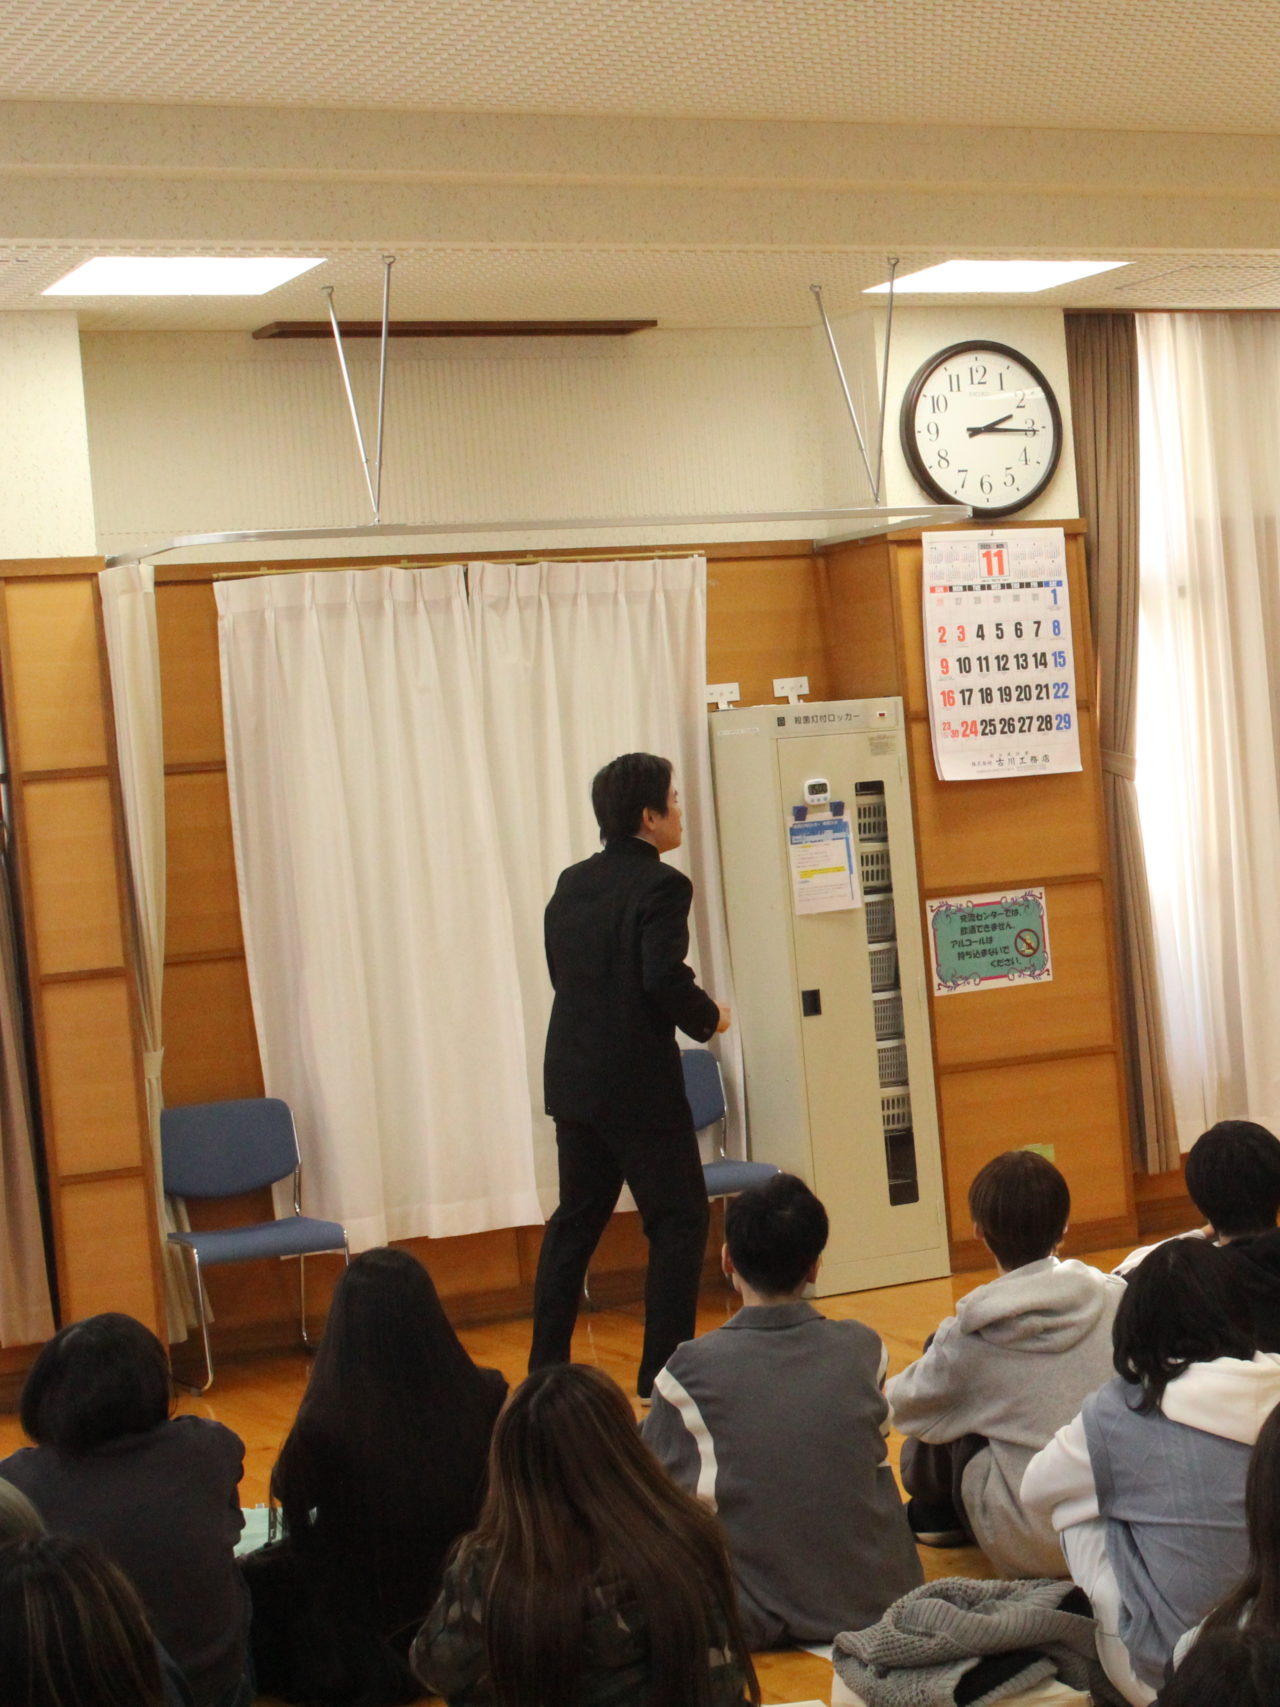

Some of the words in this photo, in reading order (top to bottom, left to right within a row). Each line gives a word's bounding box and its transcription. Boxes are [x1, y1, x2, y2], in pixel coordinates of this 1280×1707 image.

[948, 374, 961, 392] 11
[968, 365, 987, 385] 12
[997, 372, 1005, 391] 1
[931, 395, 948, 414] 10
[1015, 391, 1026, 408] 2
[927, 422, 939, 441] 9
[1024, 418, 1036, 438] 3
[937, 449, 950, 469] 8
[1018, 446, 1030, 466] 4
[957, 470, 968, 489] 7
[980, 474, 993, 495] 6
[1003, 467, 1016, 487] 5
[982, 550, 1004, 576] 11
[1050, 588, 1058, 605] 1
[938, 626, 947, 643] 2
[957, 625, 966, 642] 3
[976, 624, 985, 641] 4
[995, 623, 1004, 640] 5
[1014, 622, 1023, 638] 6
[1033, 621, 1042, 638] 7
[1052, 619, 1061, 636] 8
[940, 658, 950, 675] 9
[956, 656, 972, 674] 10
[976, 655, 990, 672] 11
[994, 654, 1010, 671] 12
[1014, 653, 1029, 670] 13
[1032, 652, 1048, 669] 14
[1051, 651, 1066, 668] 15
[940, 689, 956, 707] 16
[959, 688, 974, 706] 17
[978, 687, 993, 704] 18
[997, 686, 1012, 703] 19
[1015, 684, 1032, 702] 20
[1035, 683, 1050, 701] 21
[1052, 682, 1070, 699] 22
[794, 712, 860, 725] 殺菌灯付ロッカー
[942, 721, 951, 731] 23
[950, 729, 960, 738] 30
[961, 720, 979, 738] 24
[980, 719, 997, 736] 25
[999, 717, 1016, 735] 26
[1018, 716, 1034, 733] 27
[1036, 714, 1053, 732] 28
[1055, 713, 1072, 730] 29
[951, 936, 993, 949] アルコールは
